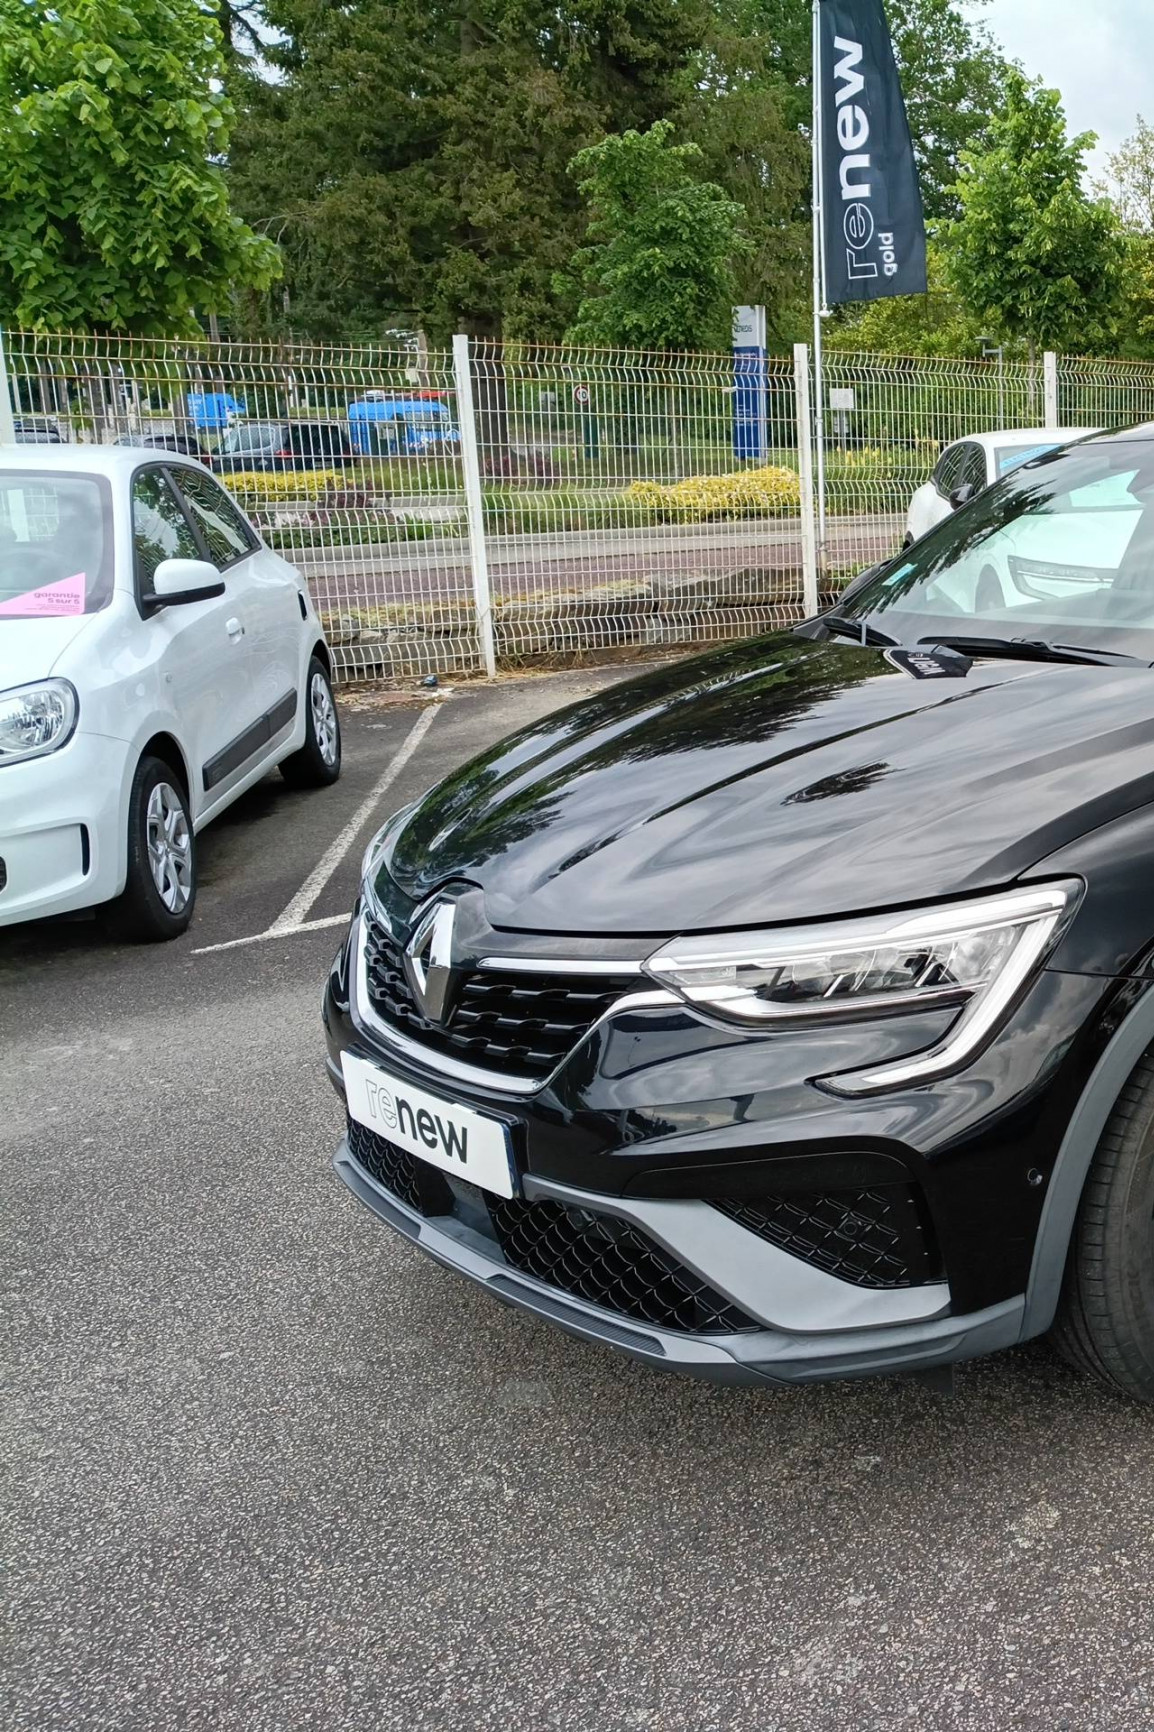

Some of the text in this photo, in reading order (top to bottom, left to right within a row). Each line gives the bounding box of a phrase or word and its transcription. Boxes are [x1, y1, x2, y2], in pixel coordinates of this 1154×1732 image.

[833, 35, 878, 280] renew
[877, 231, 898, 276] gold
[365, 1078, 468, 1165] renew
